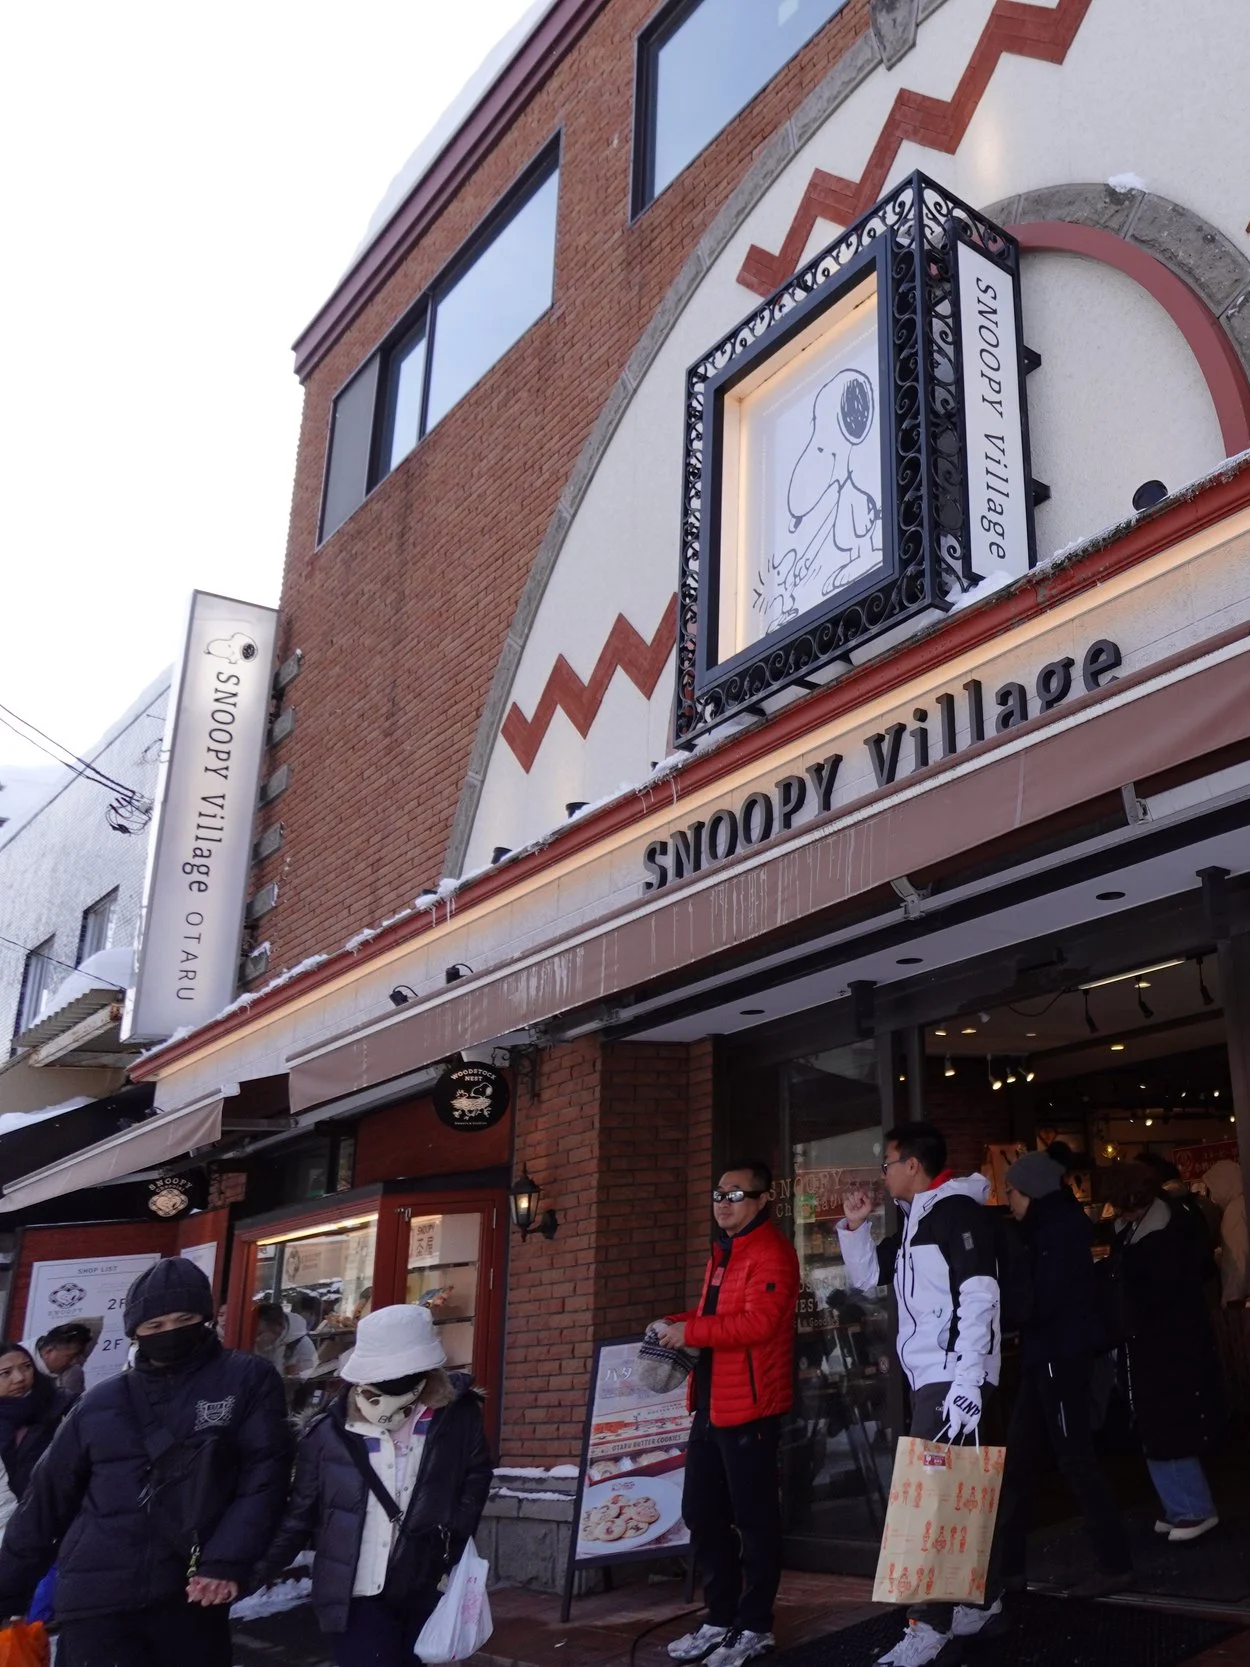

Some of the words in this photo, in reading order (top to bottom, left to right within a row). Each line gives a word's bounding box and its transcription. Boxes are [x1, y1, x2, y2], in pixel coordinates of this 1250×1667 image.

[976, 276, 1004, 419] SNOOPY
[980, 431, 1009, 560] Village
[204, 671, 240, 780] SNOOPY
[642, 753, 843, 892] SNOOPY
[863, 638, 1122, 789] Village
[182, 793, 226, 892] Village
[176, 911, 204, 1001] OTARU
[450, 1068, 497, 1080] WOODSTOCK
[148, 1177, 193, 1191] SNOOPY
[102, 1338, 123, 1351] 2F
[107, 1298, 126, 1310] 2F
[656, 1435, 682, 1446] COOKIES
